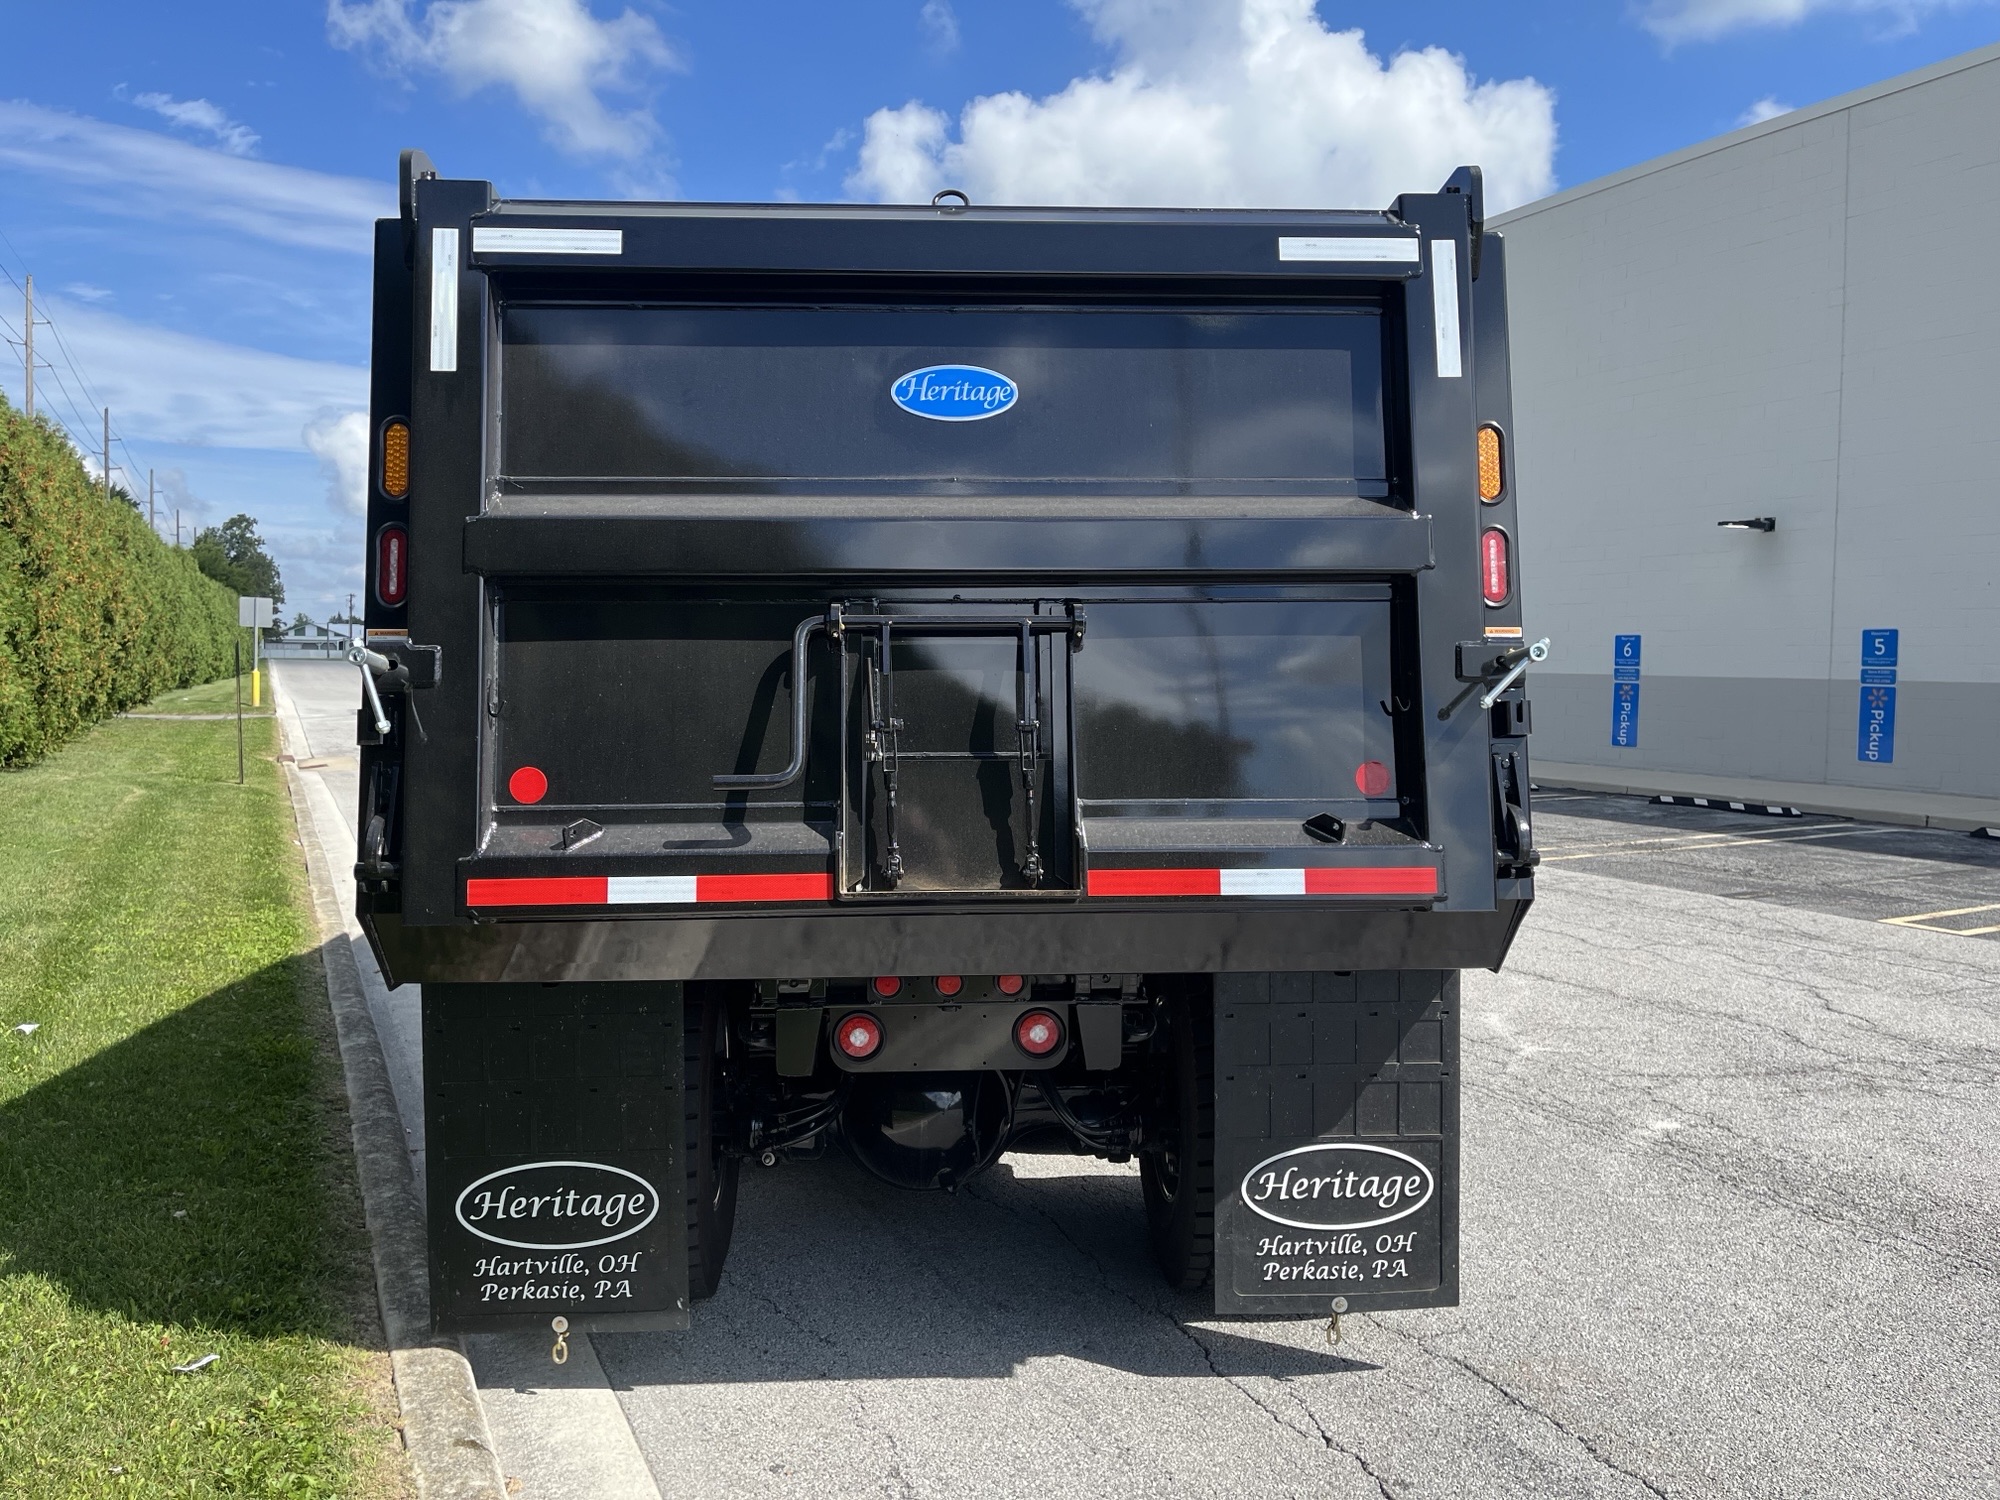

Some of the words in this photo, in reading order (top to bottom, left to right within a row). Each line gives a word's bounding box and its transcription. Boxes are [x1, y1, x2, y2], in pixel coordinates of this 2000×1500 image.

[899, 373, 1012, 409] Heritage
[1623, 642, 1632, 657] 6
[1874, 638, 1885, 655] 5
[1617, 702, 1631, 746] Pickup
[1865, 709, 1884, 761] Pickup
[1254, 1167, 1421, 1208] Heritage
[469, 1186, 645, 1227] Heritage
[1256, 1233, 1367, 1256] Hartville,
[1375, 1231, 1417, 1253] OH
[473, 1253, 590, 1277] Hartville,
[599, 1251, 642, 1274] OH
[1263, 1259, 1364, 1281] Perkasie,
[1371, 1258, 1408, 1278] PA
[480, 1279, 585, 1302] Perkasie,
[594, 1279, 633, 1299] PA
